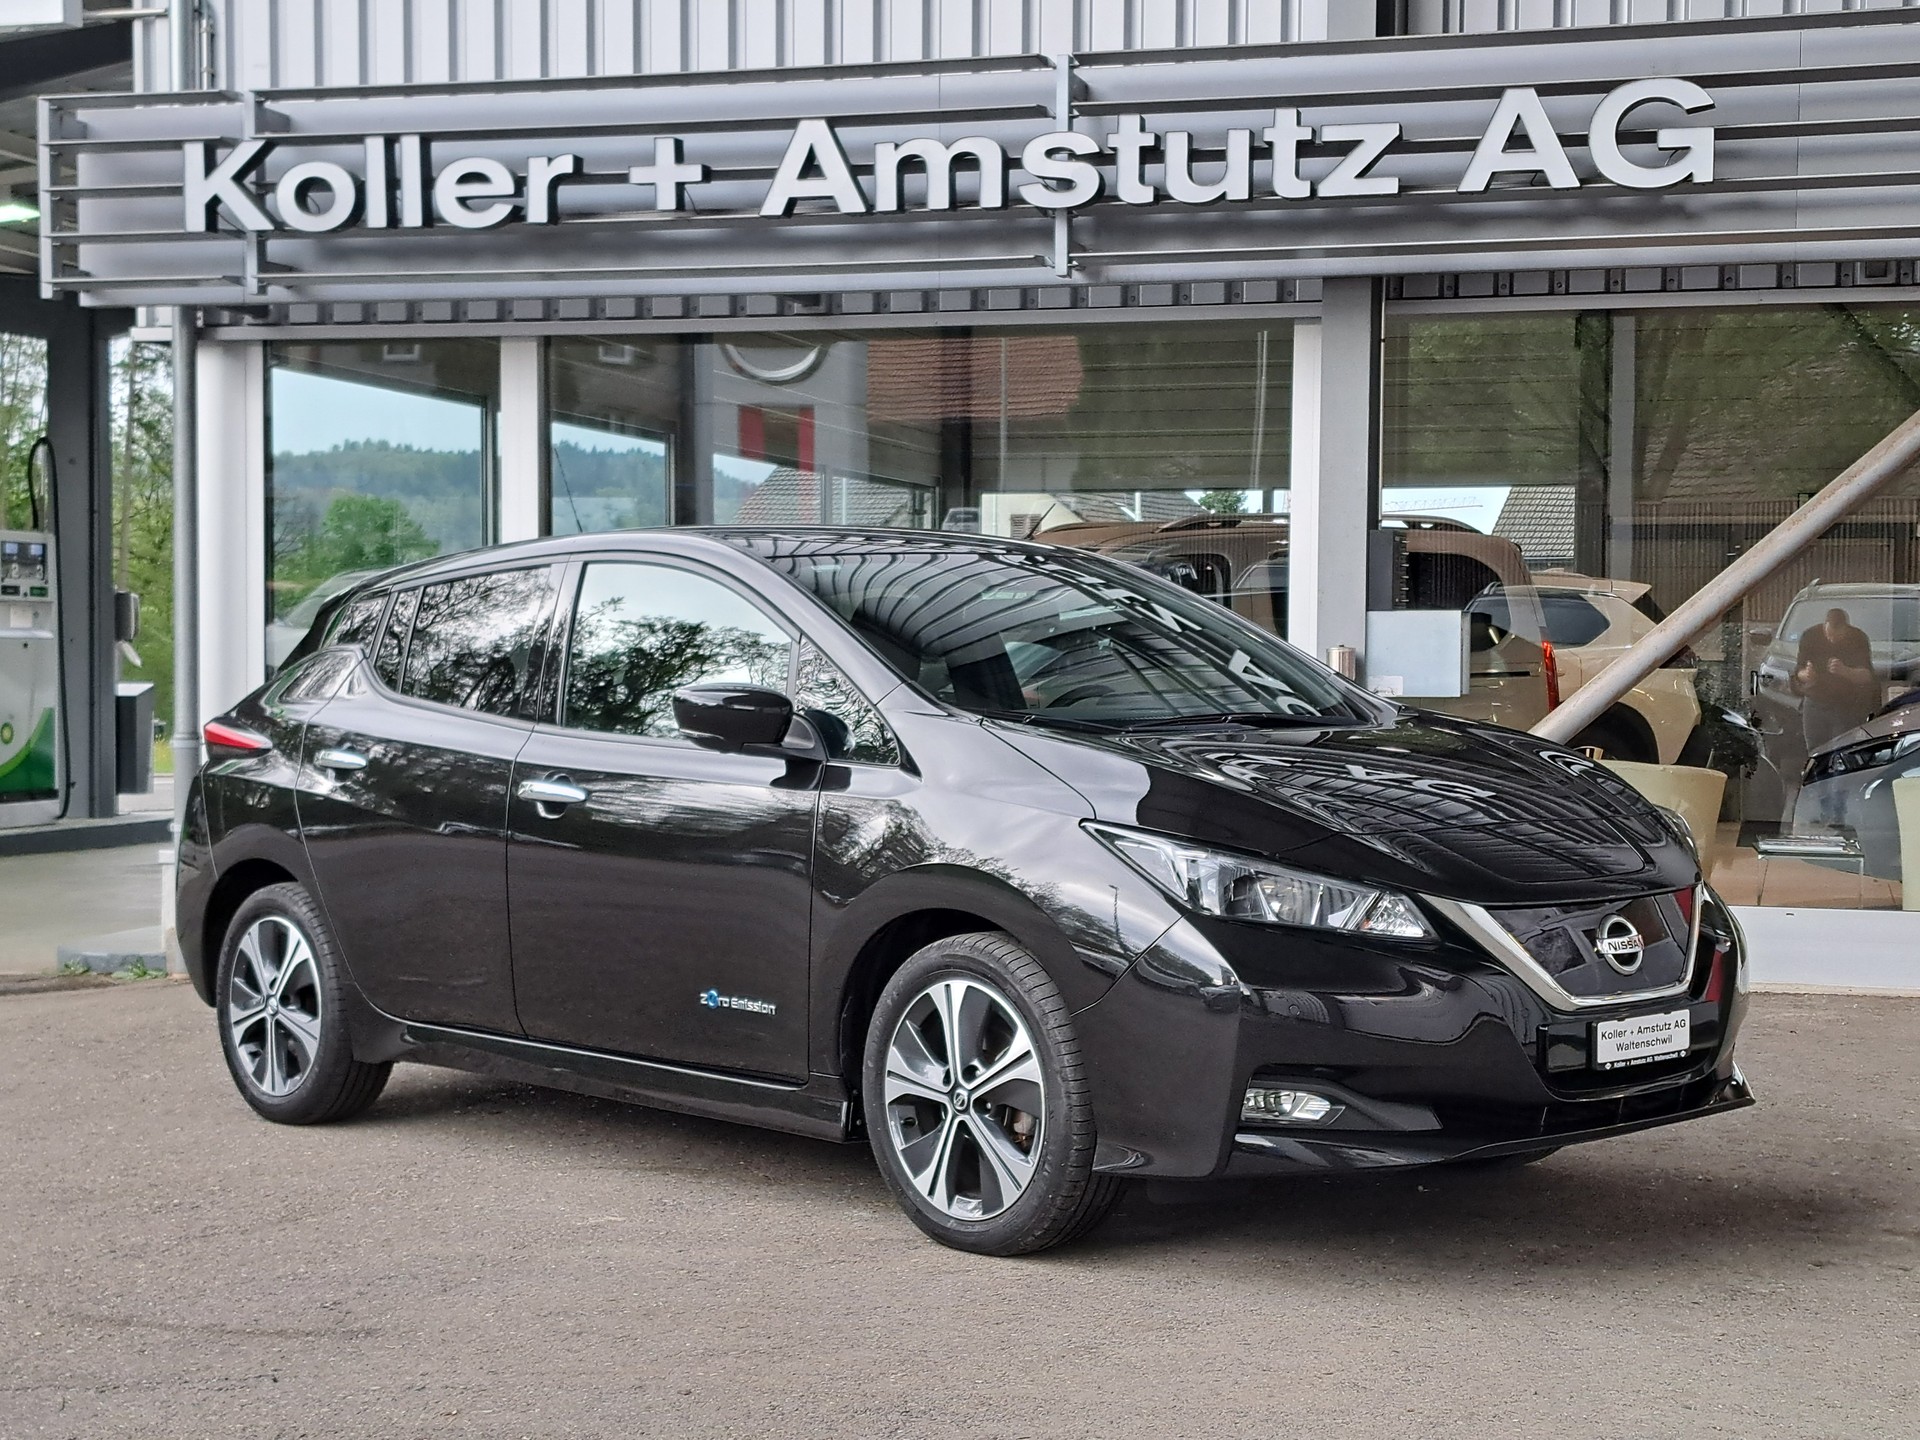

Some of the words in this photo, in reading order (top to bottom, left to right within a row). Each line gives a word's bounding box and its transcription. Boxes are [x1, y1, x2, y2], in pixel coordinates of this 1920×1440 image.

[183, 134, 580, 233] Koller
[627, 137, 707, 212] +
[759, 107, 1402, 218] Amstutz
[1456, 77, 1717, 193] AG
[730, 997, 777, 1015] Emission
[1601, 1029, 1627, 1040] Koller
[1636, 1021, 1672, 1035] Amstutz
[1674, 1018, 1686, 1029] AG
[1616, 1034, 1673, 1052] Waltenschwil
